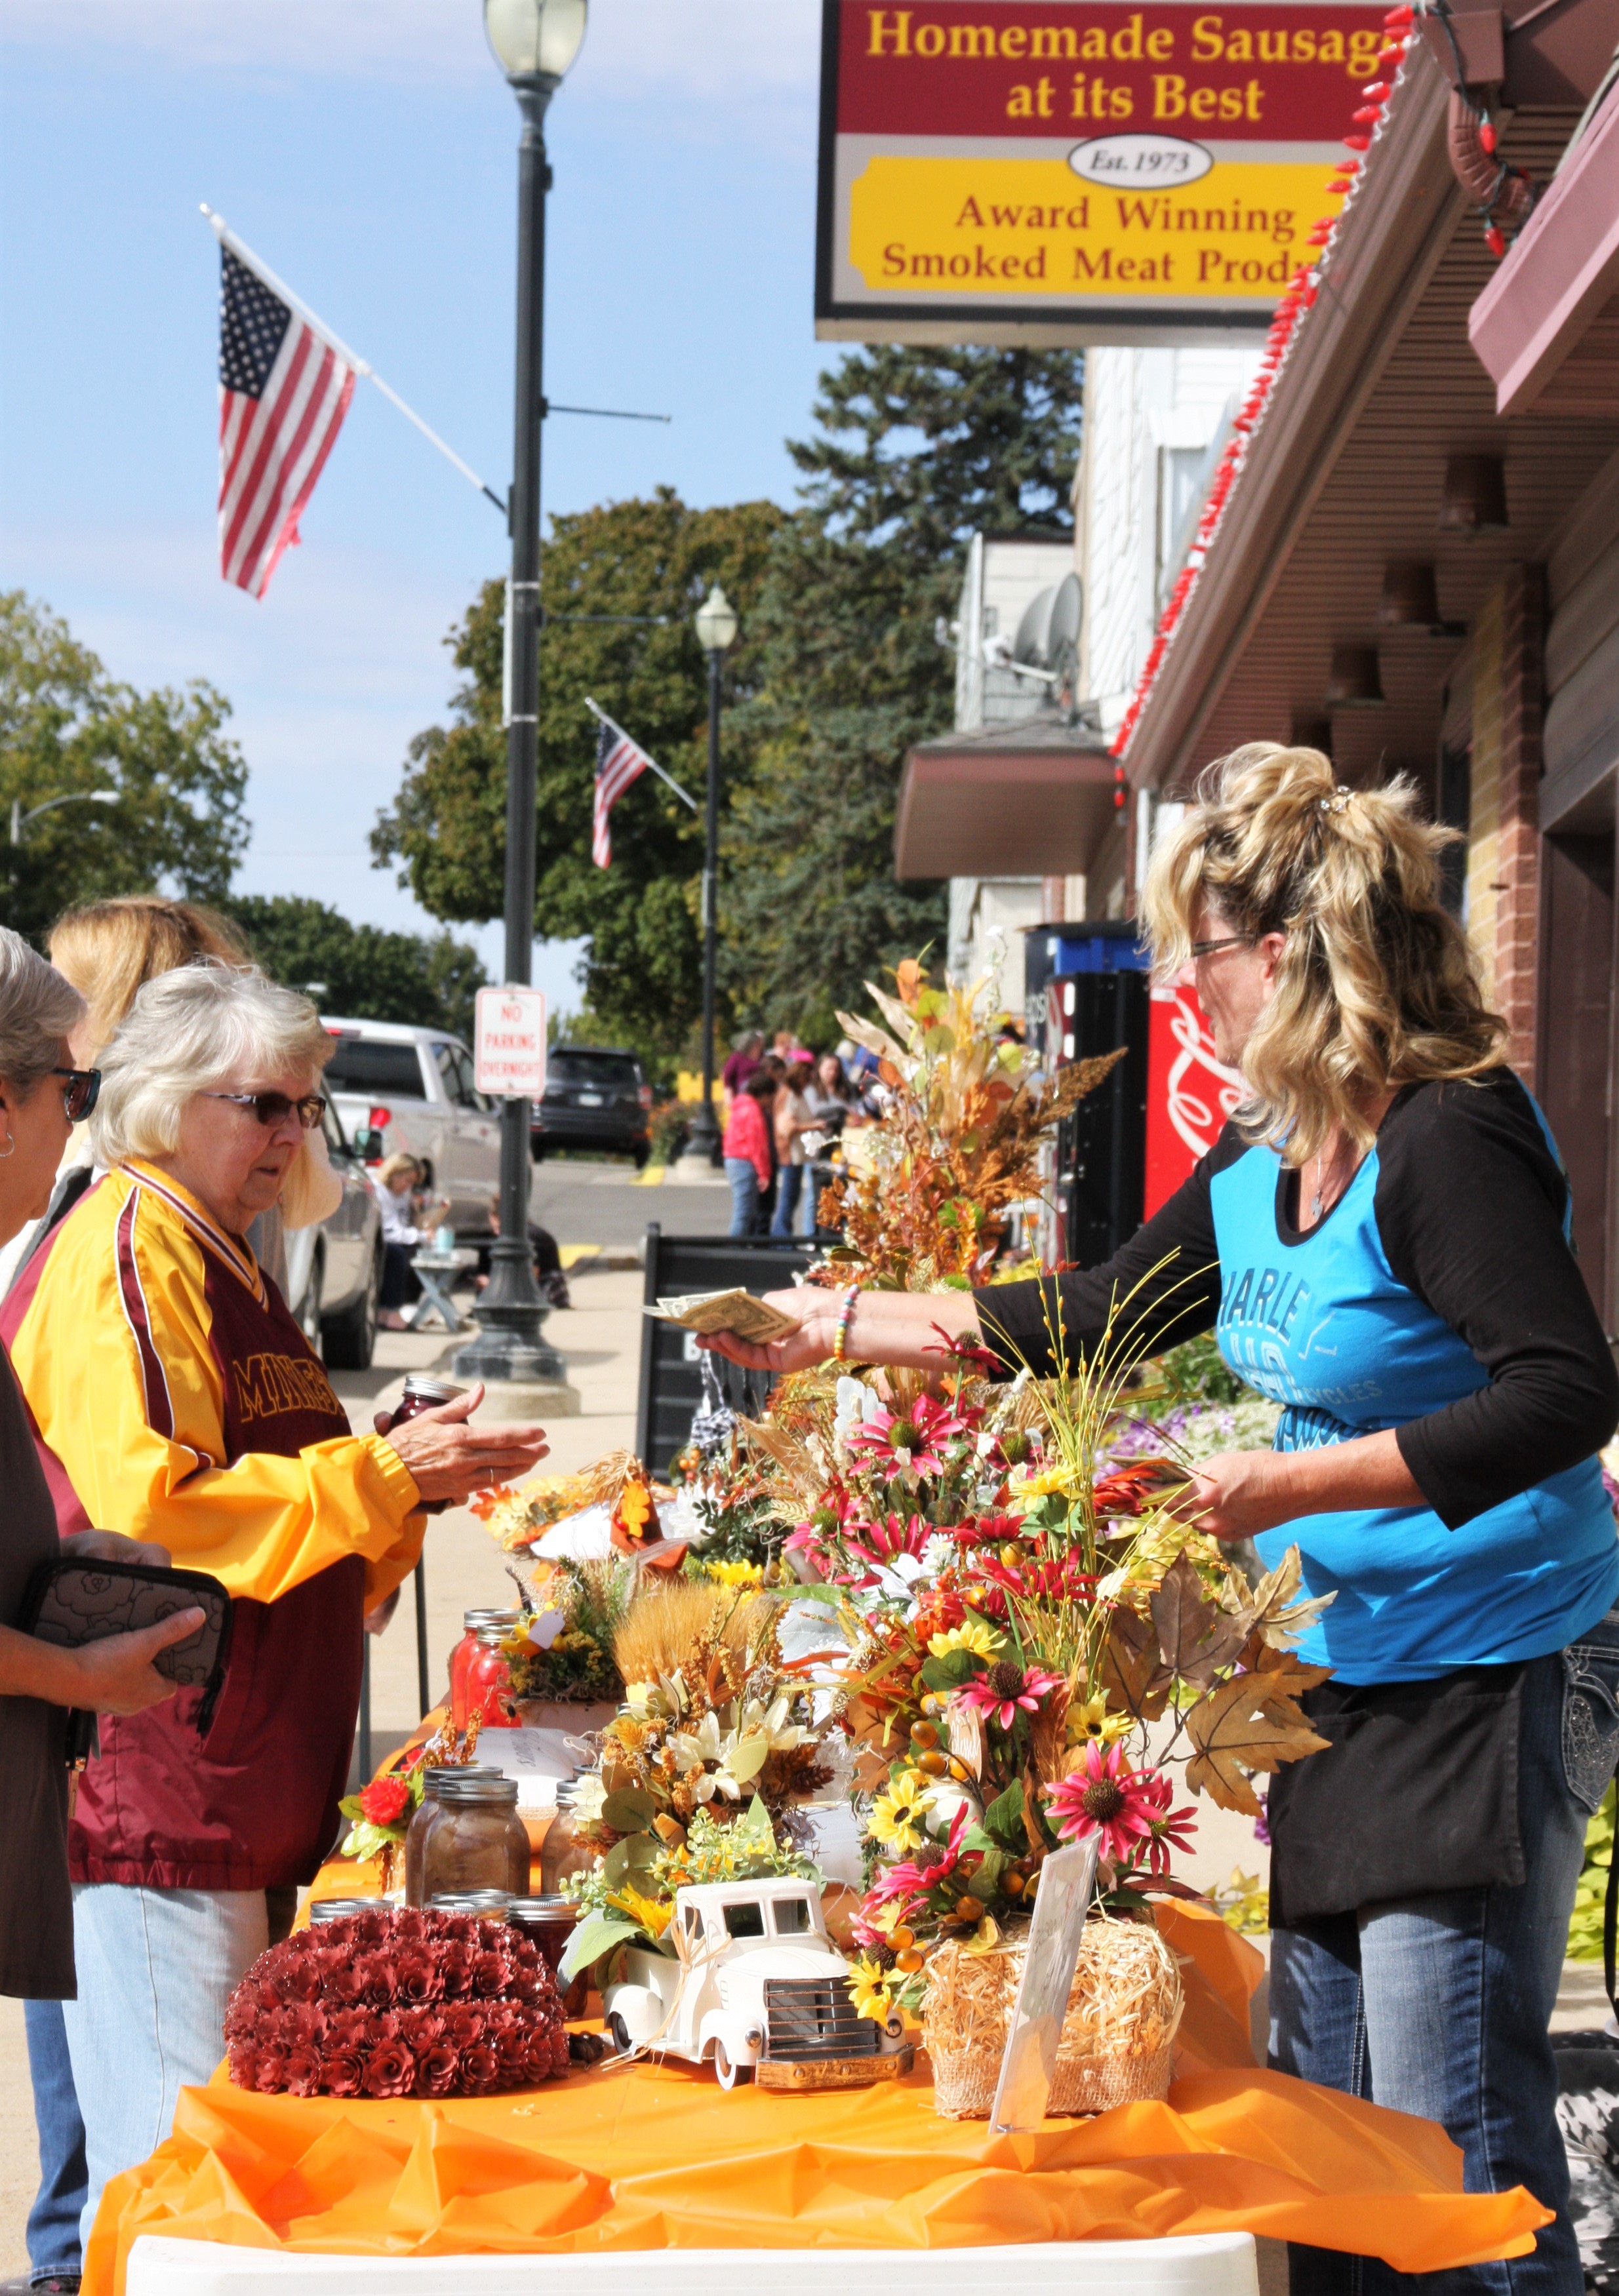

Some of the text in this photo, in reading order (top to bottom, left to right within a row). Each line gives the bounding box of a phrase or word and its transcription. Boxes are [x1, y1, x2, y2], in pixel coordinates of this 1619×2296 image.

[868, 10, 1174, 61] Homemade
[1006, 72, 1266, 121] at its Best
[1090, 149, 1190, 173] Est. 1973
[955, 195, 1296, 242] Award Winning
[883, 245, 1315, 283] Smoked Meat Prod
[500, 1004, 523, 1023] NO
[485, 1033, 536, 1052] PARKING
